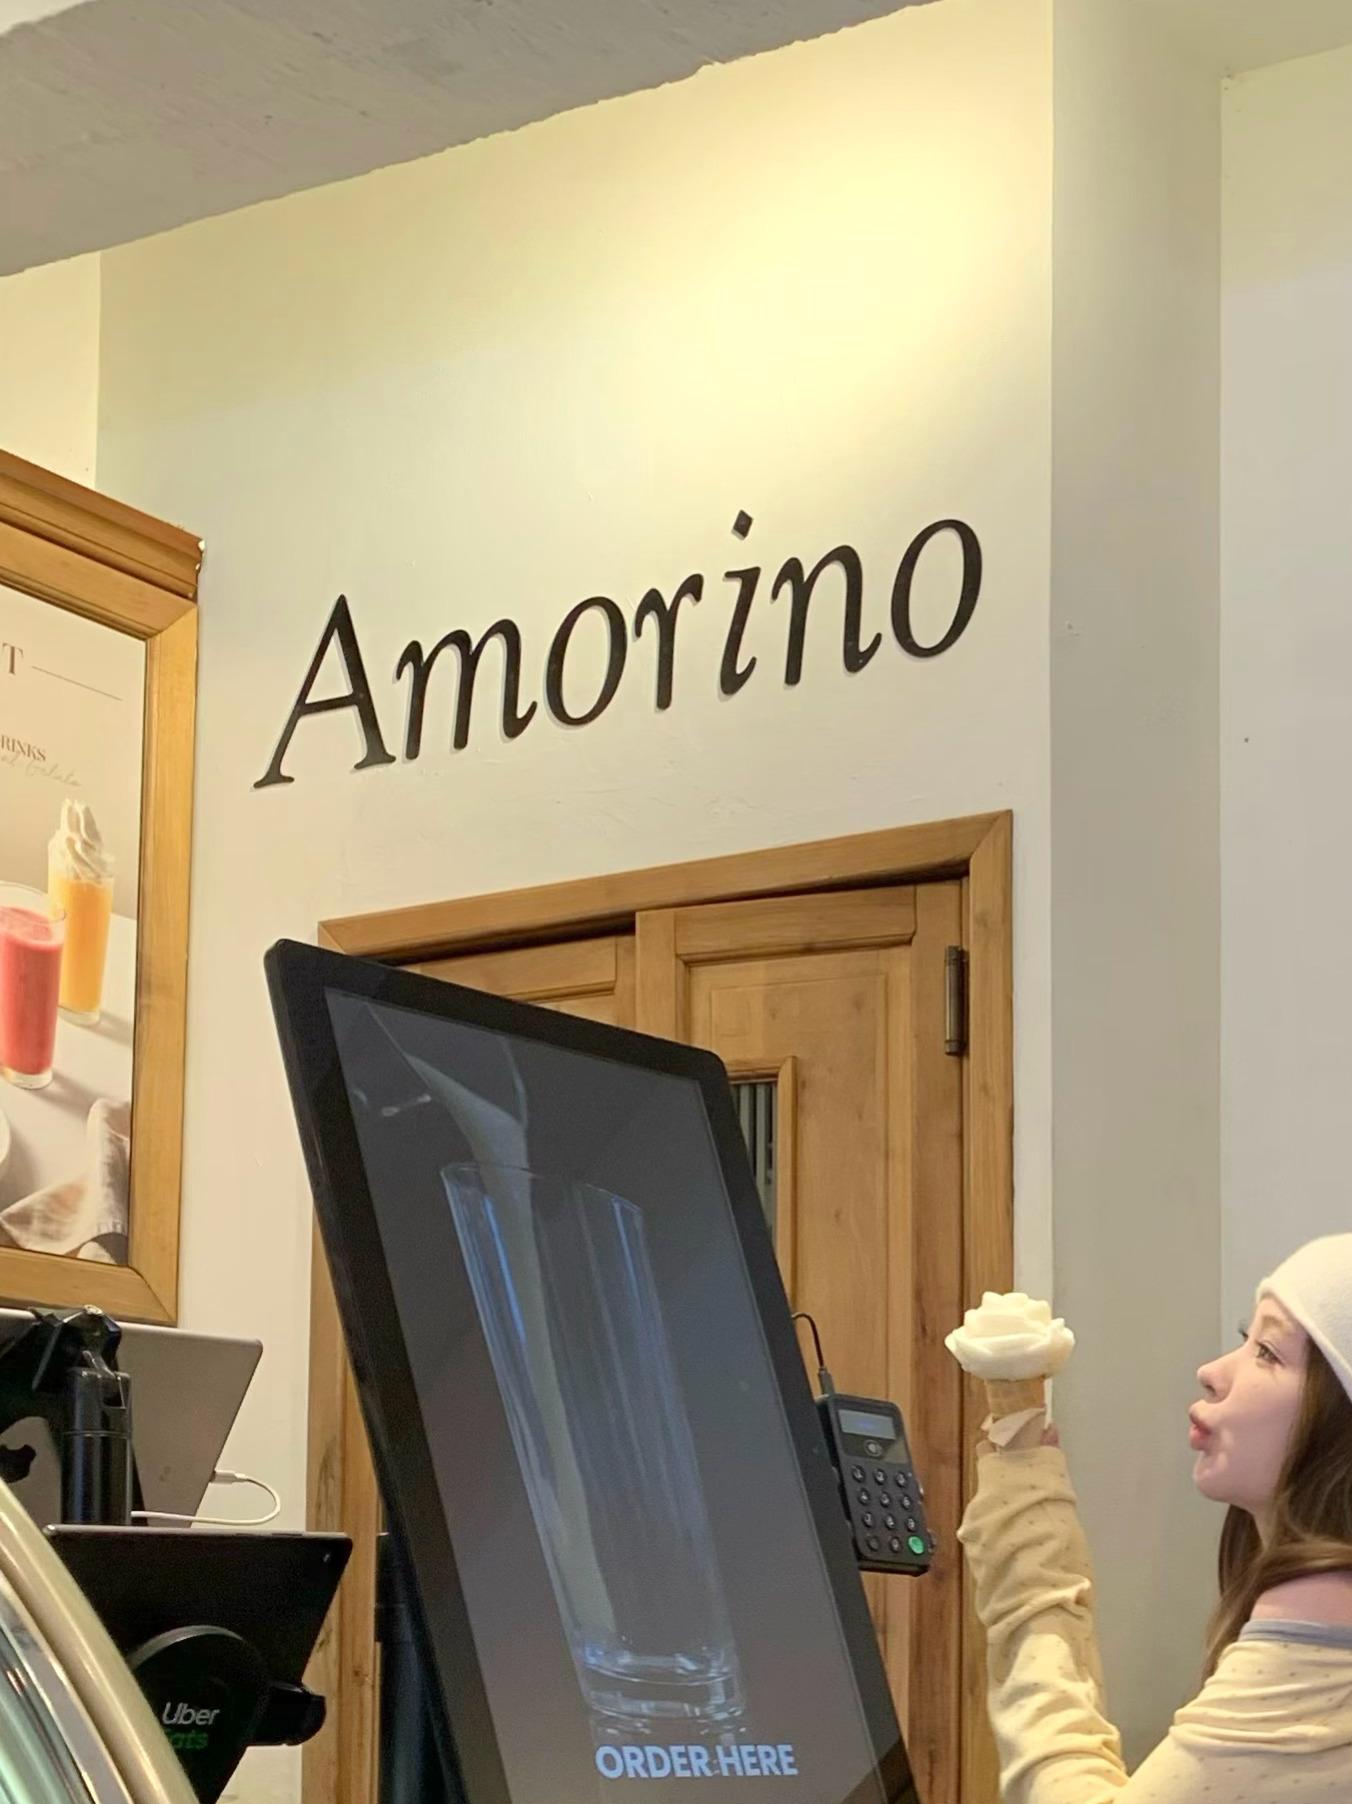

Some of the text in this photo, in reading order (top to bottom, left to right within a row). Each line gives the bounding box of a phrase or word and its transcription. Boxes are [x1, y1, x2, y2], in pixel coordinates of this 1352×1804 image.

[253, 510, 983, 788] Amorino
[162, 1702, 221, 1725] Uber
[166, 1728, 208, 1750] ats
[595, 1744, 799, 1778] ORDER HERE
